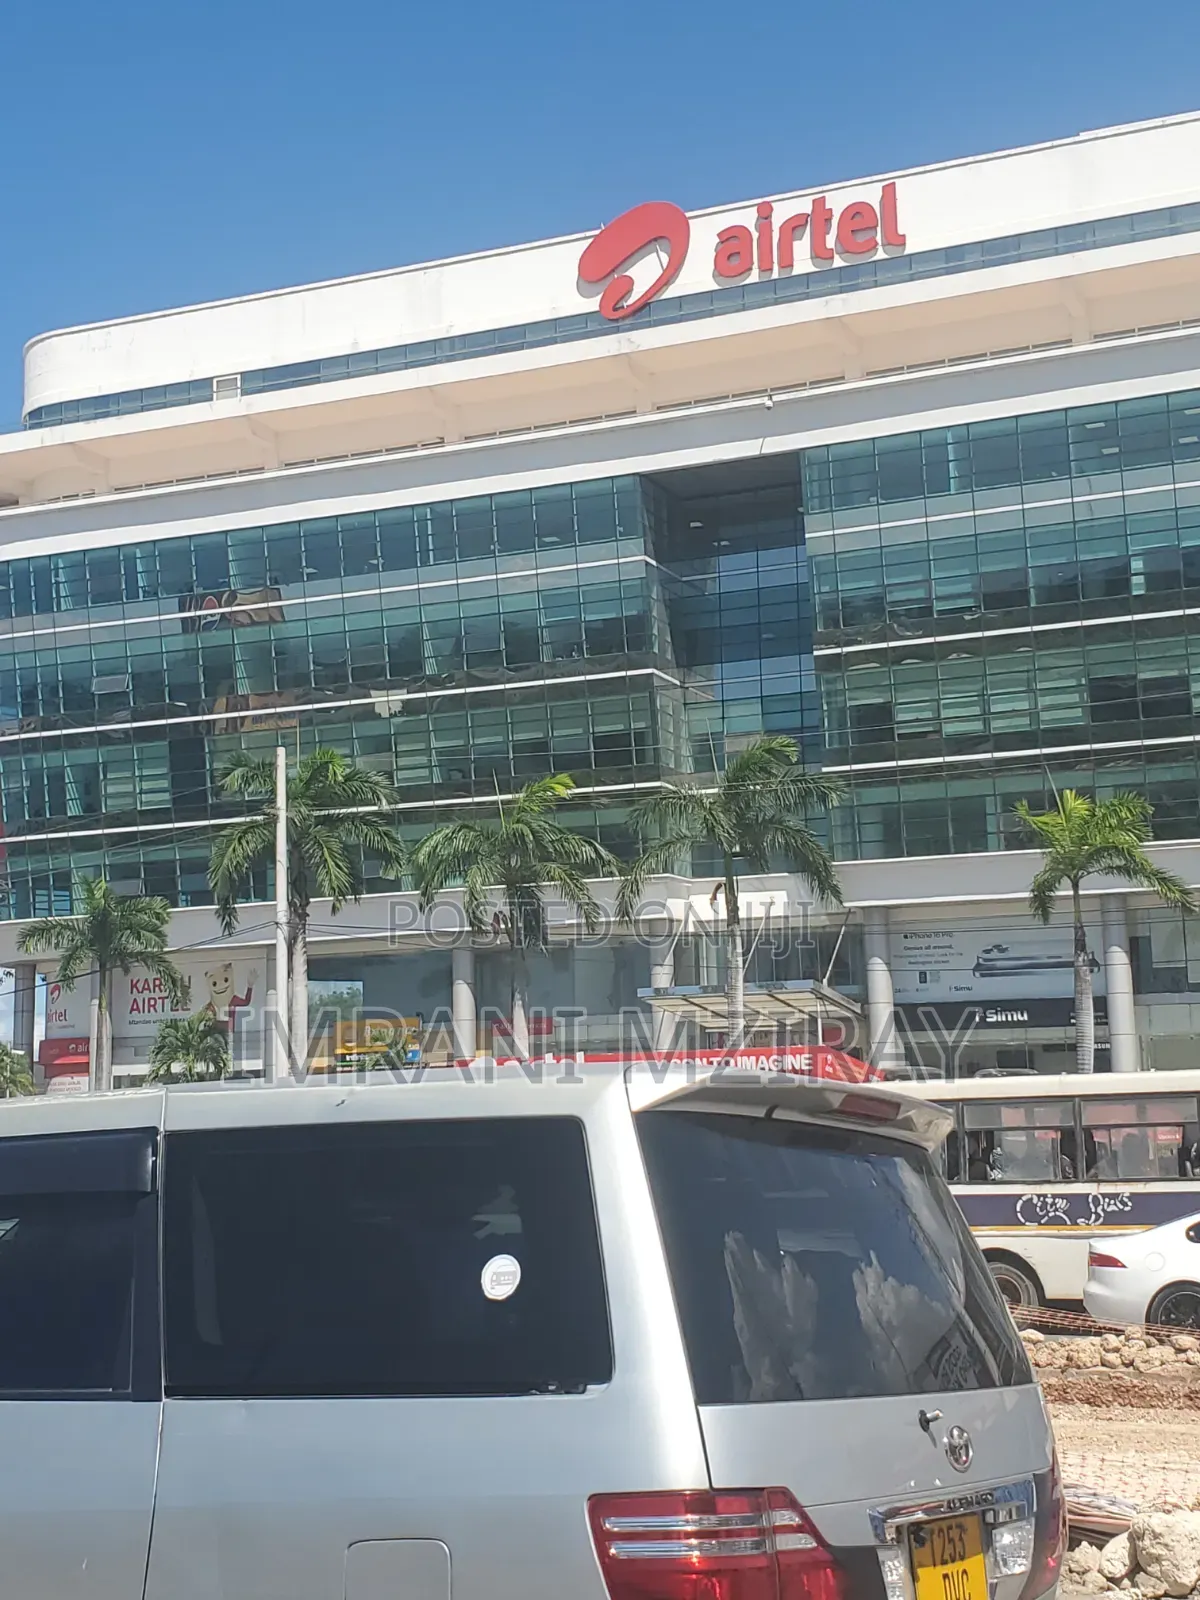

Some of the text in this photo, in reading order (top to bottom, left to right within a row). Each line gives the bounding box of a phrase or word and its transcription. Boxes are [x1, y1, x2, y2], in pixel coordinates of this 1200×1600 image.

[714, 181, 906, 279] airtel
[77, 1042, 90, 1053] air
[736, 1053, 813, 1072] IMAGINE
[1077, 1191, 1133, 1226] Bus
